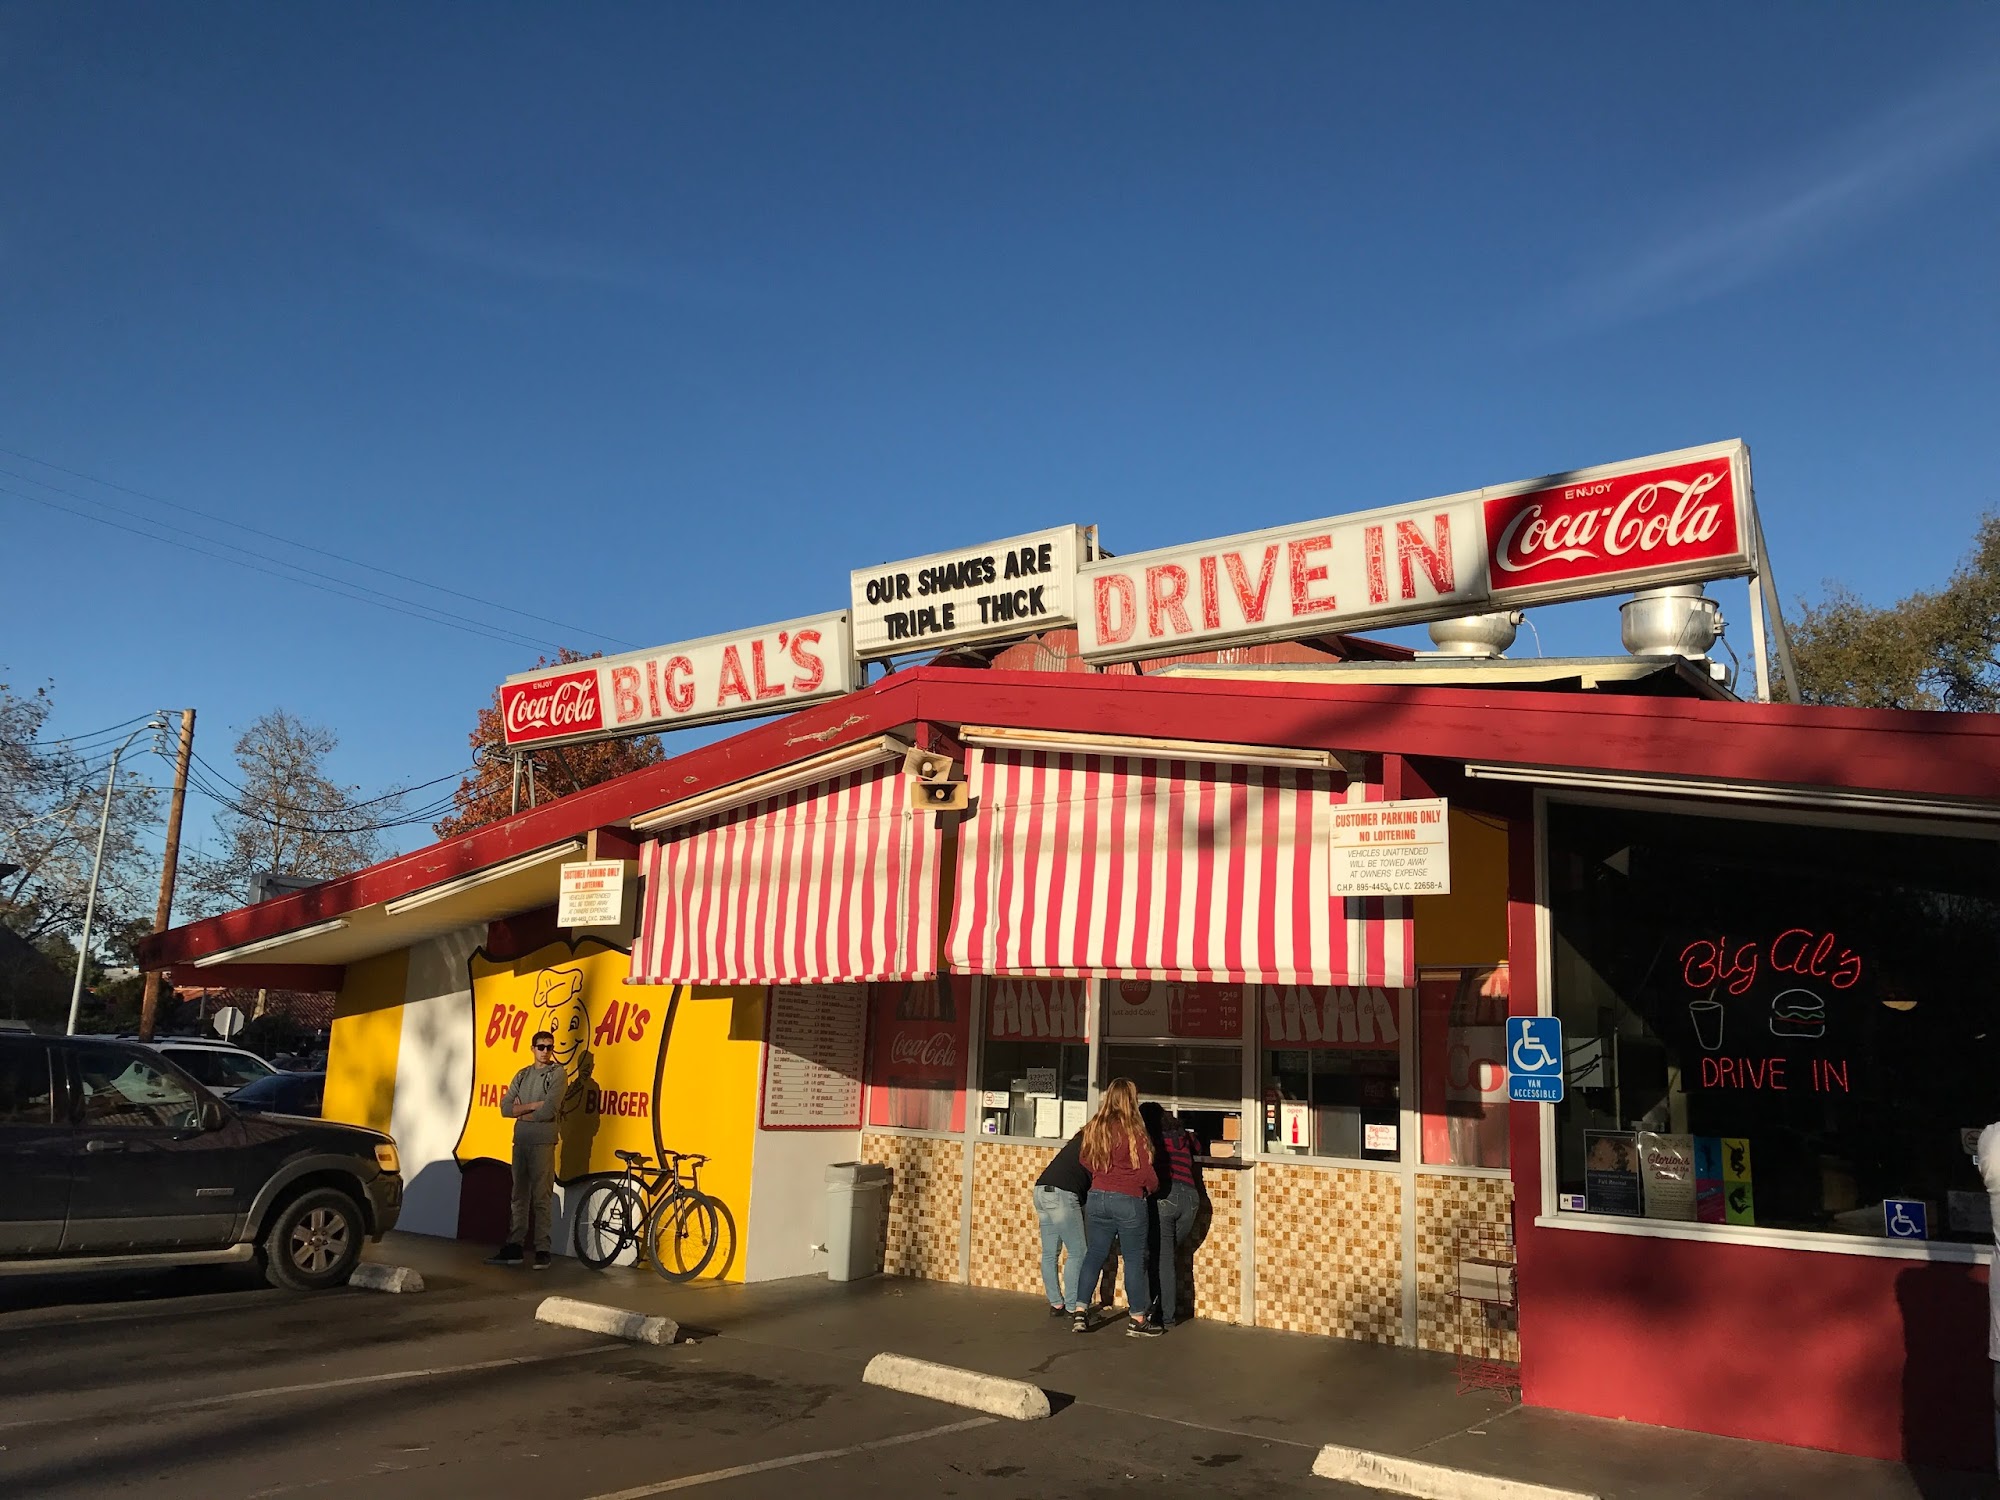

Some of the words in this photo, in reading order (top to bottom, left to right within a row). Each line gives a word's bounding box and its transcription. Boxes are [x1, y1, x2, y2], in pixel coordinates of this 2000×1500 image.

[1565, 483, 1612, 500] ENJOY
[1496, 470, 1728, 572] Coca-Cola
[866, 573, 911, 605] OUR
[917, 556, 996, 597] SHAKES
[1003, 543, 1052, 580] ARE
[1093, 535, 1337, 646] DRIVE
[1364, 513, 1456, 606] IN
[884, 602, 955, 640] TRIPLE
[977, 585, 1047, 625] THICK
[533, 680, 553, 690] ENJOY
[611, 655, 696, 723] BIG
[717, 629, 825, 707] AL'S
[507, 677, 597, 733] Coca-Cola
[1335, 813, 1378, 828] CUSTOMER
[1381, 810, 1418, 825] PARKING
[1420, 809, 1441, 824] ONLY
[1359, 831, 1370, 842] NO
[1373, 829, 1416, 842] LOITERING
[1347, 848, 1380, 858] VEHICLES
[1382, 847, 1429, 857] UNATTENDED
[1349, 860, 1365, 868] WILL
[1367, 859, 1377, 867] BE
[1380, 859, 1405, 867] TOWED
[1407, 858, 1427, 866] AWAY
[1349, 870, 1358, 878] AT
[1395, 868, 1428, 877] EXPENSE
[1414, 881, 1442, 889] 22658-A
[1680, 936, 1758, 995] Big
[485, 1003, 529, 1053] Big
[594, 999, 651, 1047] Al's
[890, 1031, 957, 1067] Coca-Cola
[1528, 1079, 1541, 1088] VAN
[1702, 1057, 1788, 1090] DRIVE
[1813, 1059, 1849, 1092] IN
[585, 1090, 649, 1118] BURGER
[1514, 1088, 1556, 1099] ACCESSIBLE
[1647, 1153, 1690, 1166] Glorious
